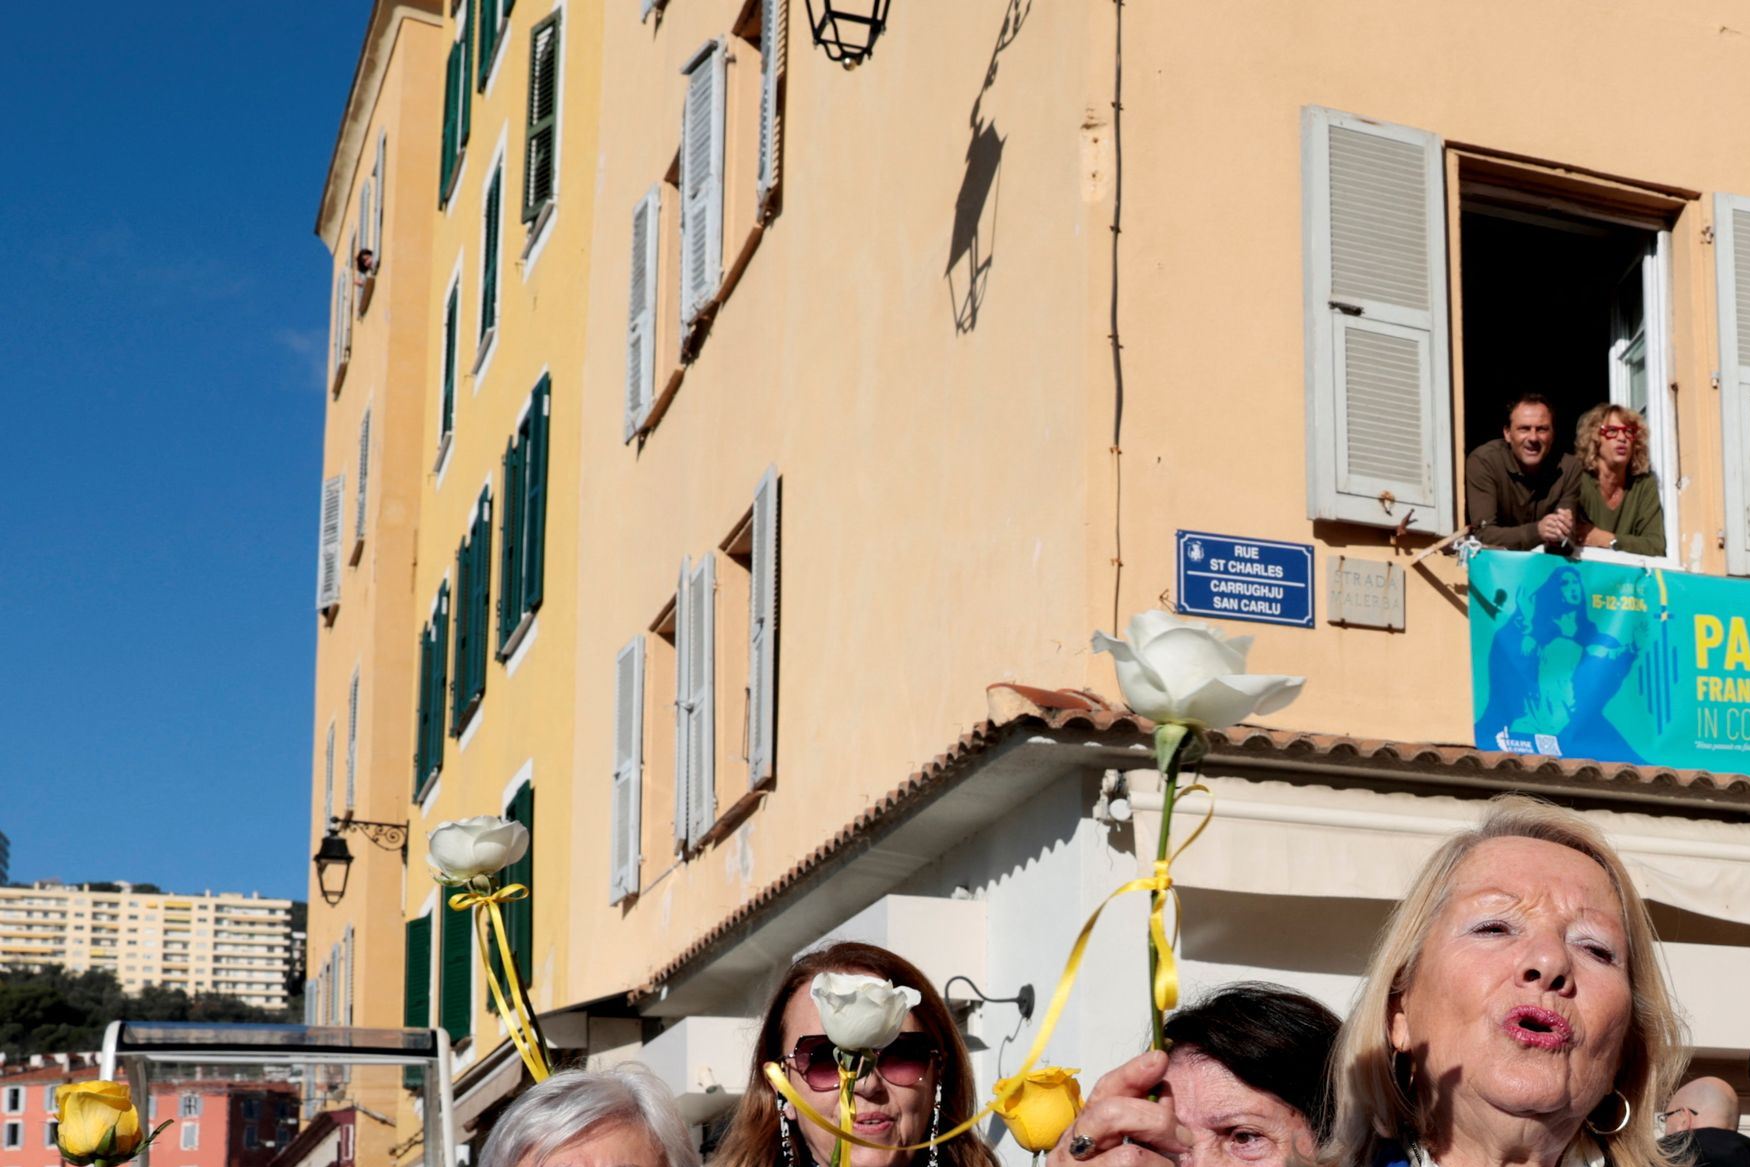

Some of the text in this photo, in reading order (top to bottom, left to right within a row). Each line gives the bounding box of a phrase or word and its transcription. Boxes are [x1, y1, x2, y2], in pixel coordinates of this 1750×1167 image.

[1234, 545, 1260, 560] RUE
[1210, 558, 1284, 579] ST CHARLES
[1210, 579, 1284, 599] CARRUGHJU
[1334, 570, 1398, 590] STRADA
[1213, 596, 1281, 615] SAN CARLU
[1697, 708, 1719, 739] IN
